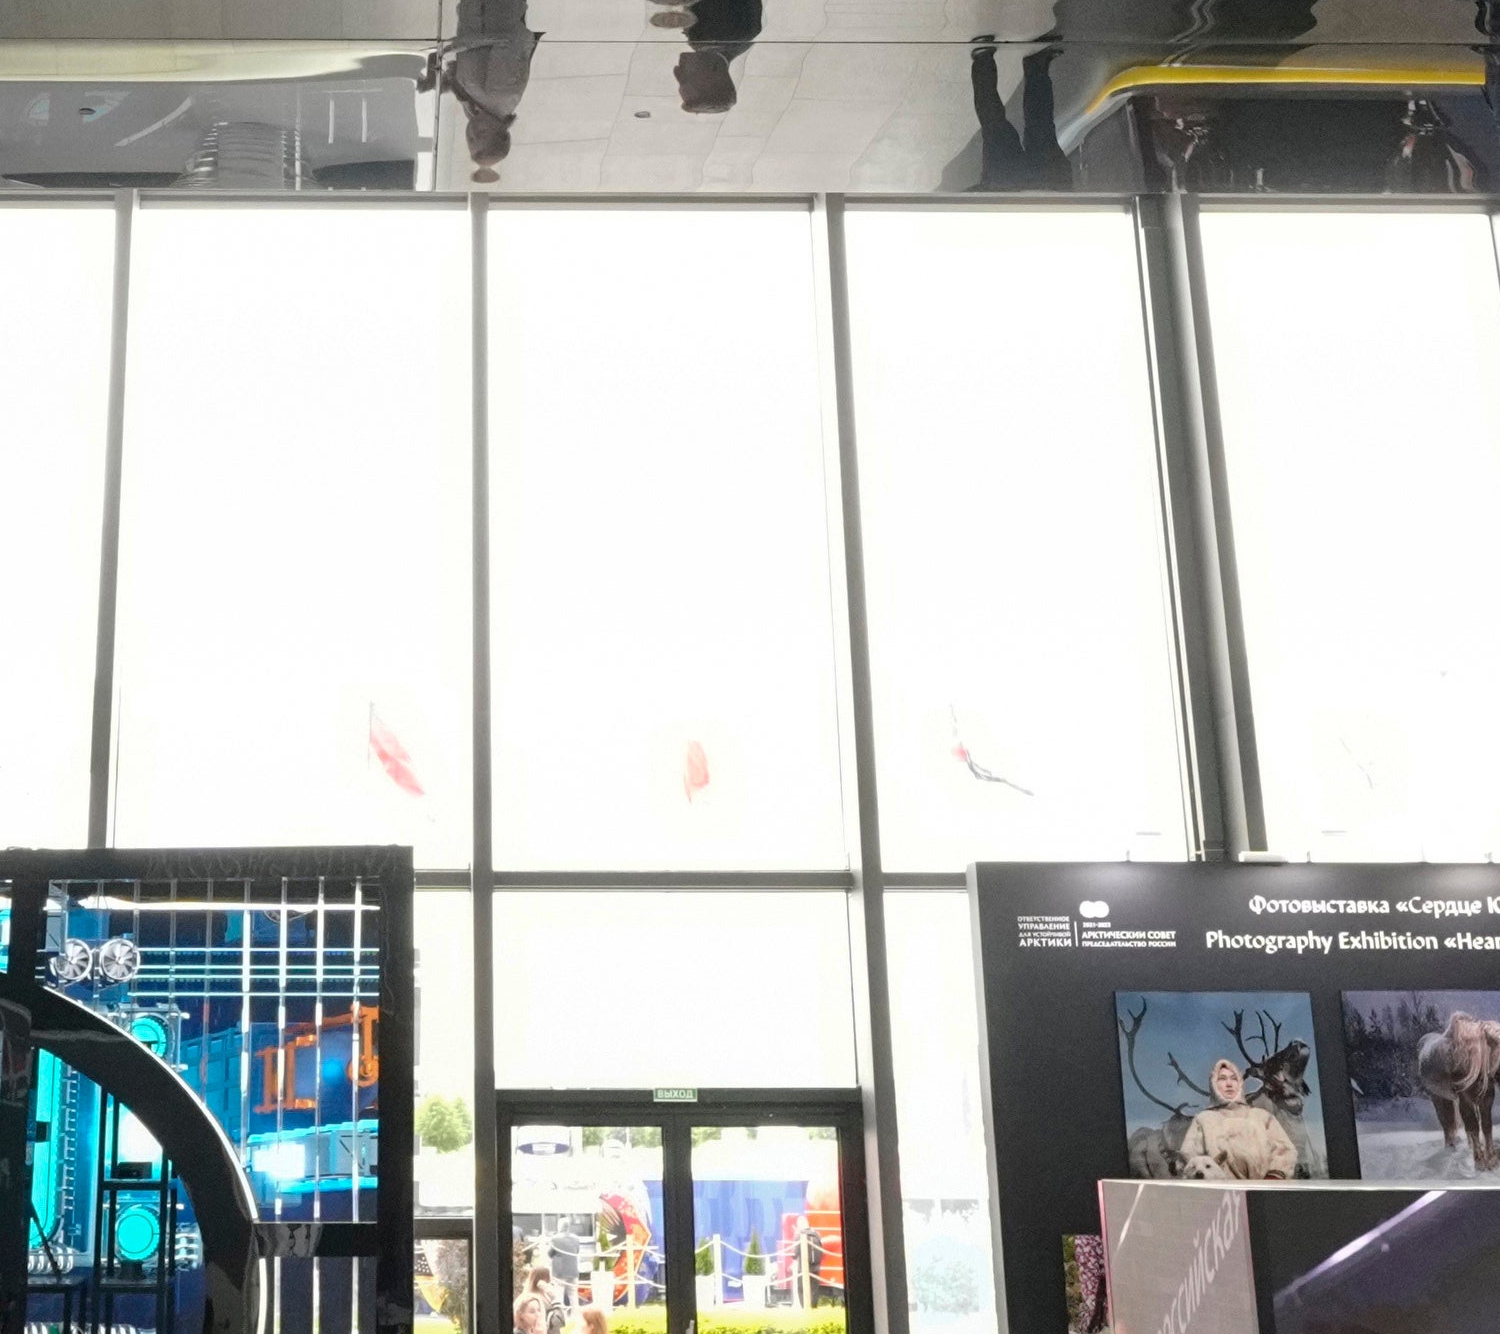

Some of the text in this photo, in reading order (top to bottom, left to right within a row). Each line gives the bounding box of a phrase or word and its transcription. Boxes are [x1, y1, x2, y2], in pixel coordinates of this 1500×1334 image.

[1249, 895, 1391, 916] Фотовыставка
[1395, 895, 1481, 919] «Сердце
[1147, 931, 1176, 939] СОВЕТ
[1019, 938, 1072, 947] АРКТИКИ
[1205, 930, 1332, 955] Photography
[1338, 930, 1439, 951] Exhibition
[657, 1089, 693, 1098] ВЫХОД
